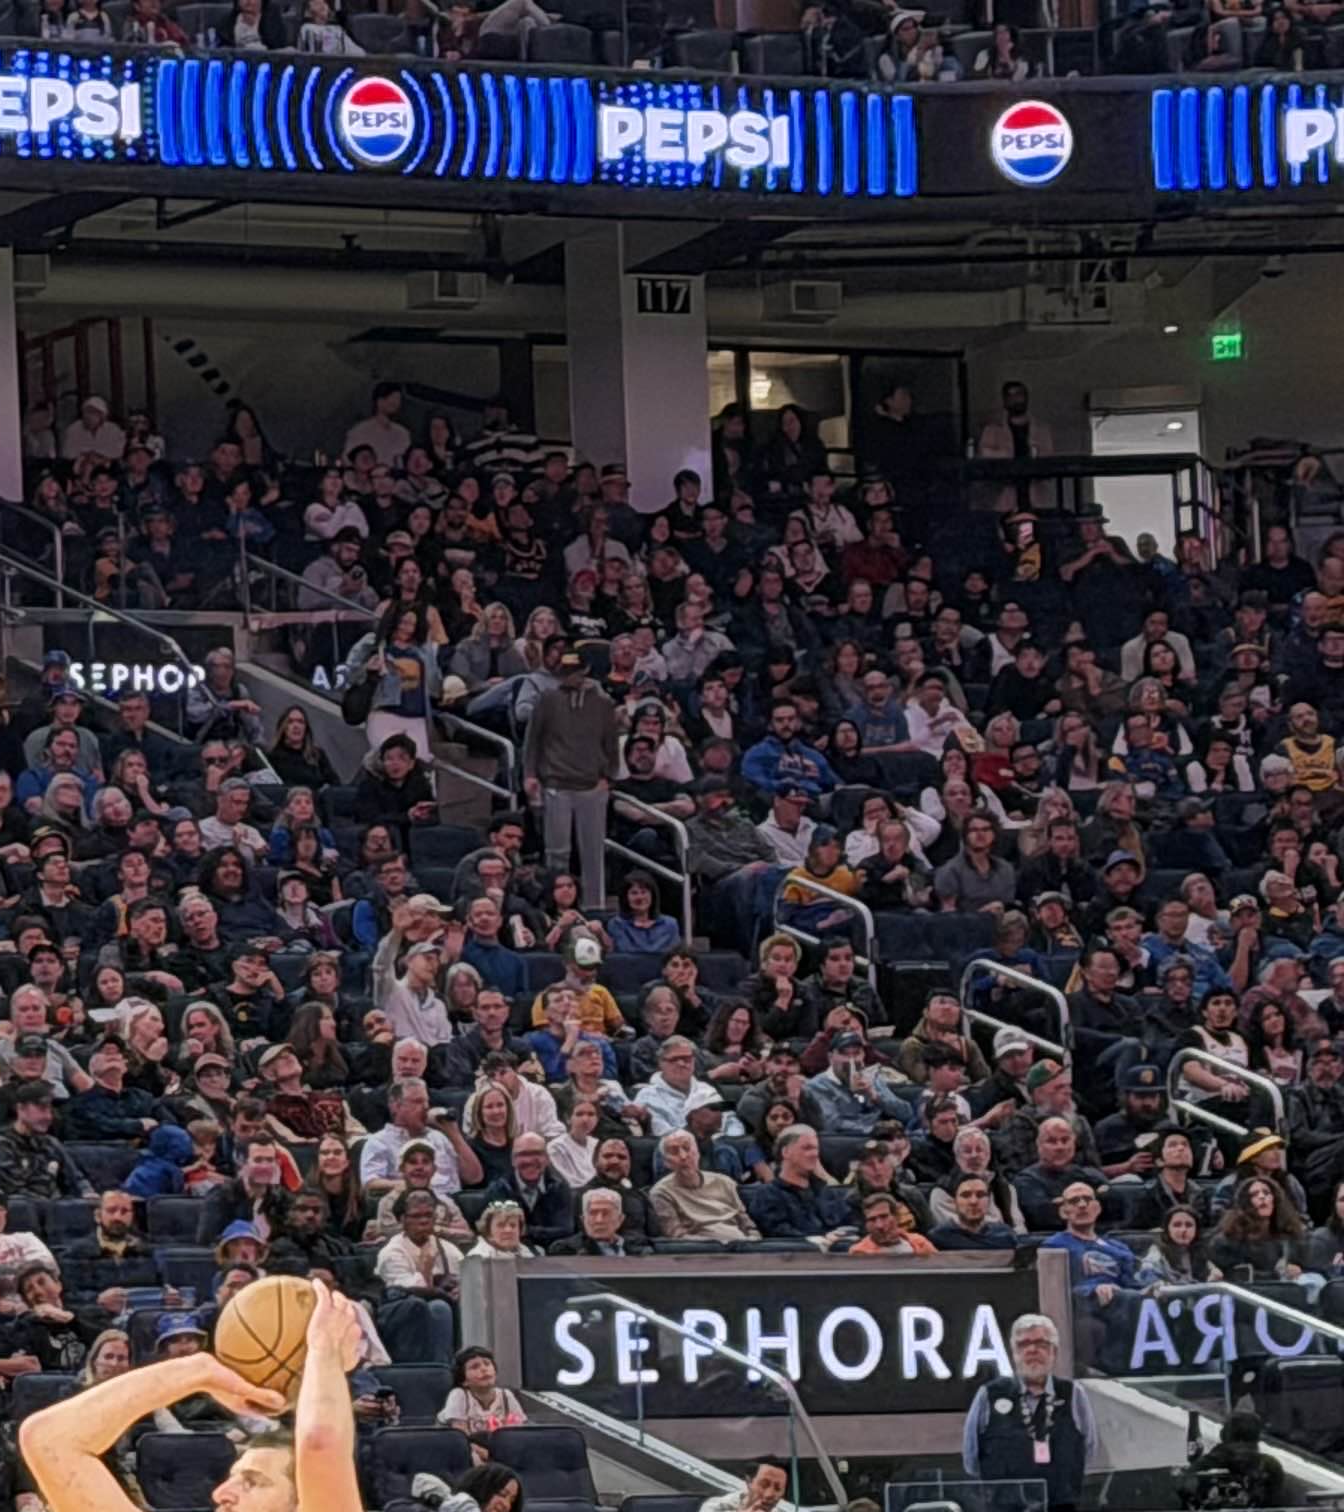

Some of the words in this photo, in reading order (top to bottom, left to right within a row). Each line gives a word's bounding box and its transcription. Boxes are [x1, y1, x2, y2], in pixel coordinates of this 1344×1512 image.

[348, 110, 409, 130] PEPSI
[598, 104, 790, 169] PEPSI
[1000, 132, 1065, 152] PEPSI
[640, 280, 689, 312] 117
[555, 1303, 1014, 1386] SEPHORA
